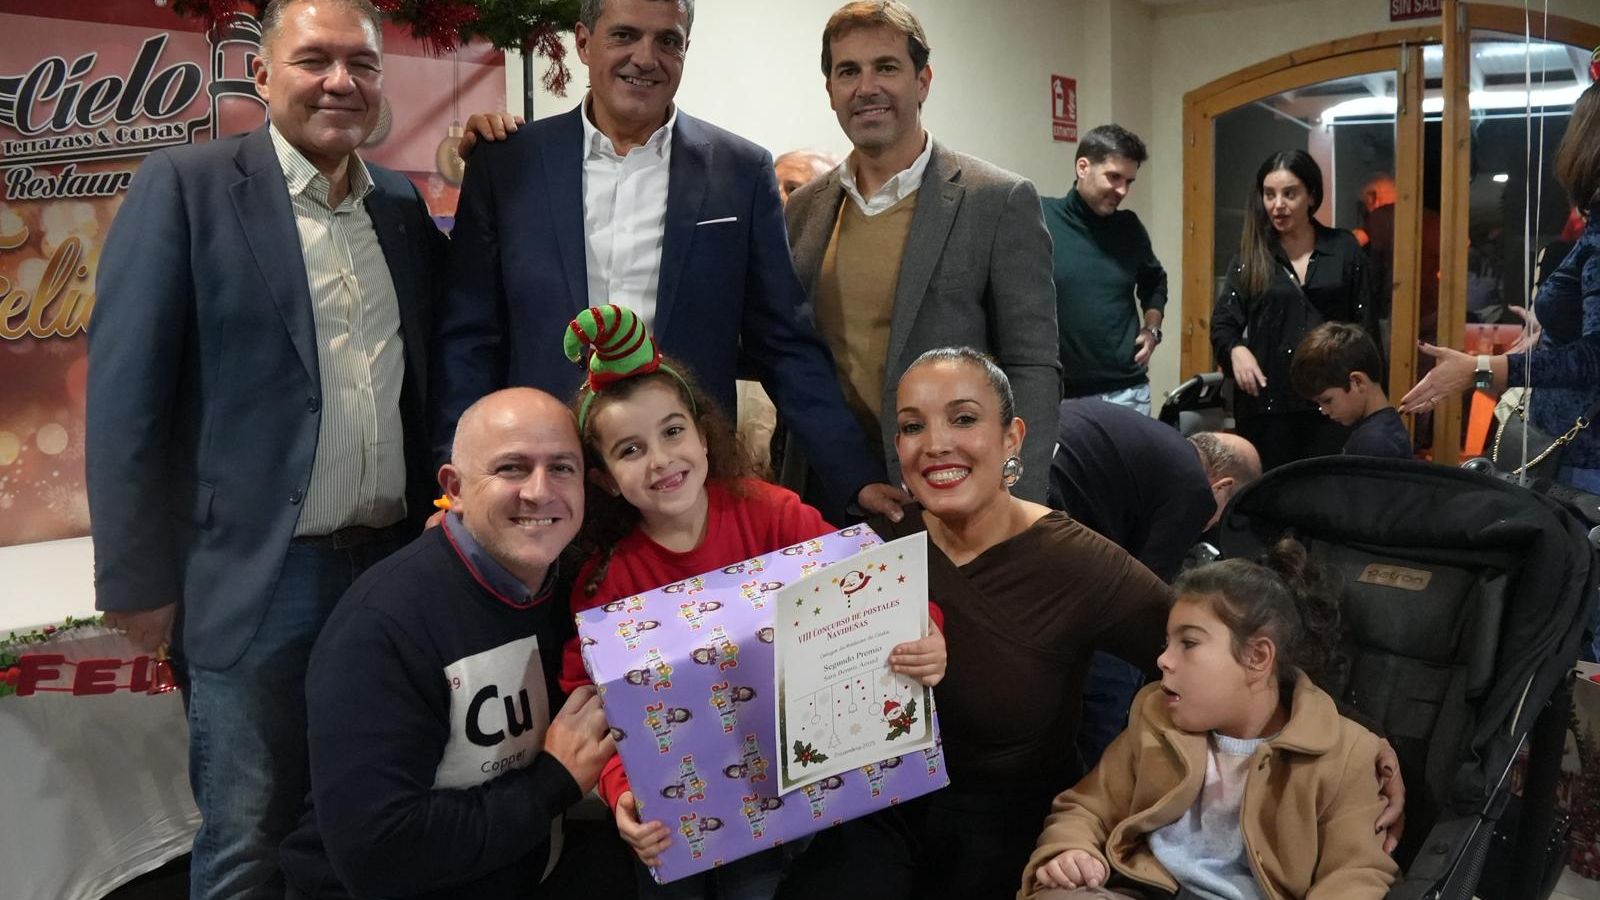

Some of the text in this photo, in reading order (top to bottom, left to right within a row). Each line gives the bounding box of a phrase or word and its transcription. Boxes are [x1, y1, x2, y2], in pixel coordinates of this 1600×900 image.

[1391, 0, 1411, 16] SIN
[15, 32, 203, 136] Cielo
[3, 122, 186, 156] Terrazass & Copas
[0, 226, 97, 340] eli
[863, 599, 901, 617] POSTALES
[823, 655, 855, 672] Segundo
[856, 646, 883, 660] Premio
[465, 684, 533, 747] Cu
[480, 749, 528, 773] Copper
